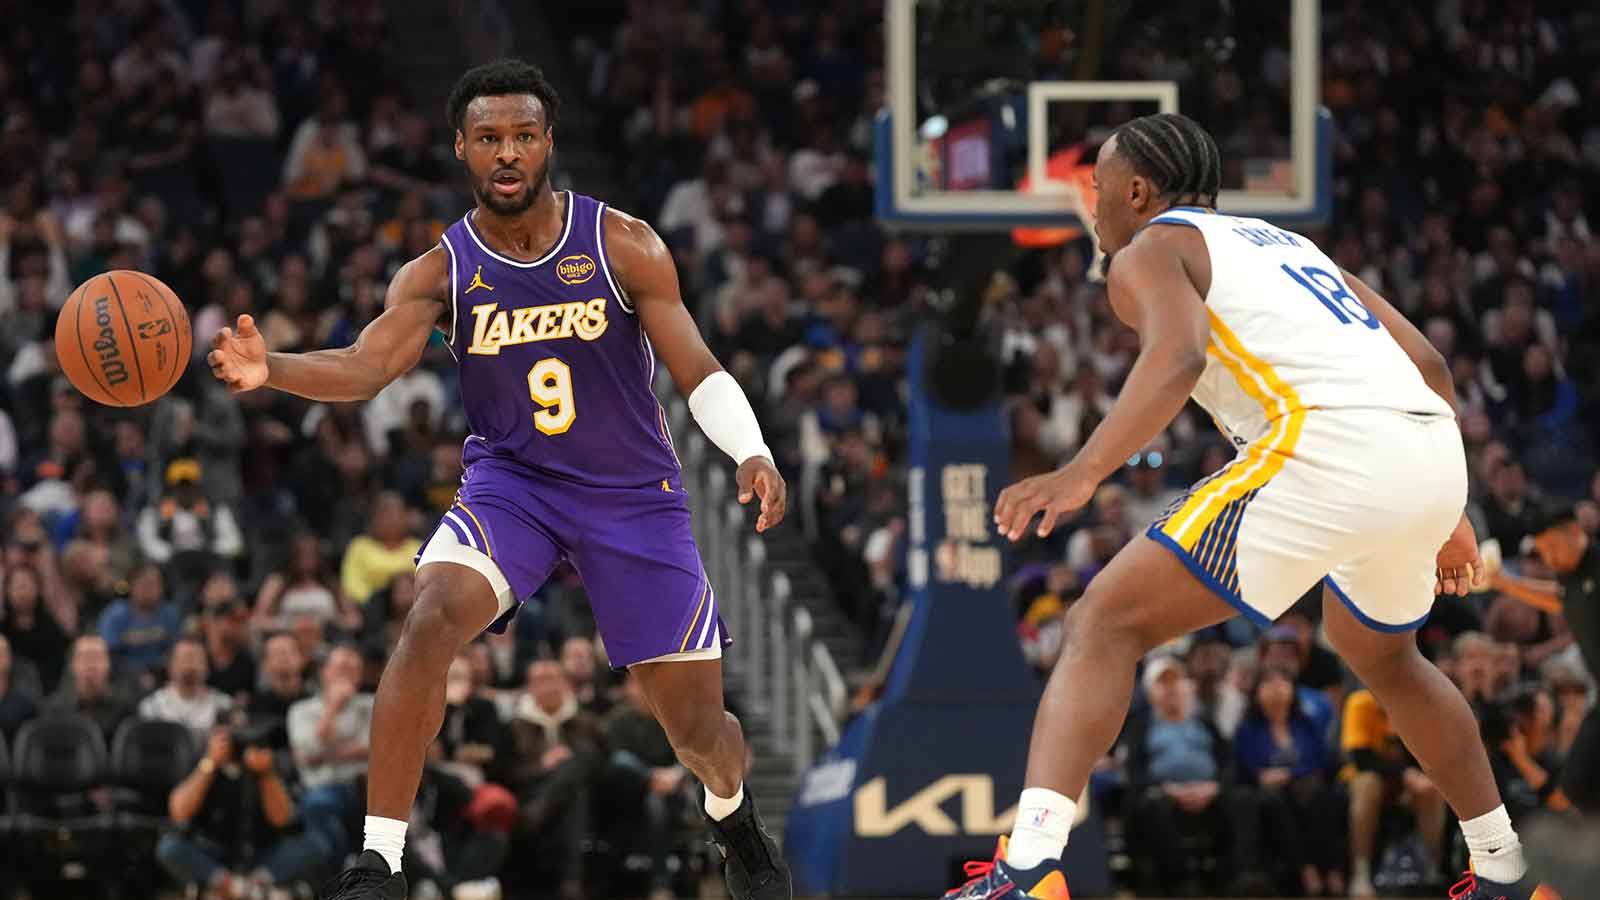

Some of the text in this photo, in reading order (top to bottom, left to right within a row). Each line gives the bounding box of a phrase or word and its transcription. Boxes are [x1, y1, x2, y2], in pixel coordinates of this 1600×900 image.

[560, 262, 593, 274] bibigo
[1280, 263, 1380, 330] 18
[94, 296, 128, 386] Wilson
[467, 298, 608, 355] LAKERS
[527, 357, 577, 436] 9
